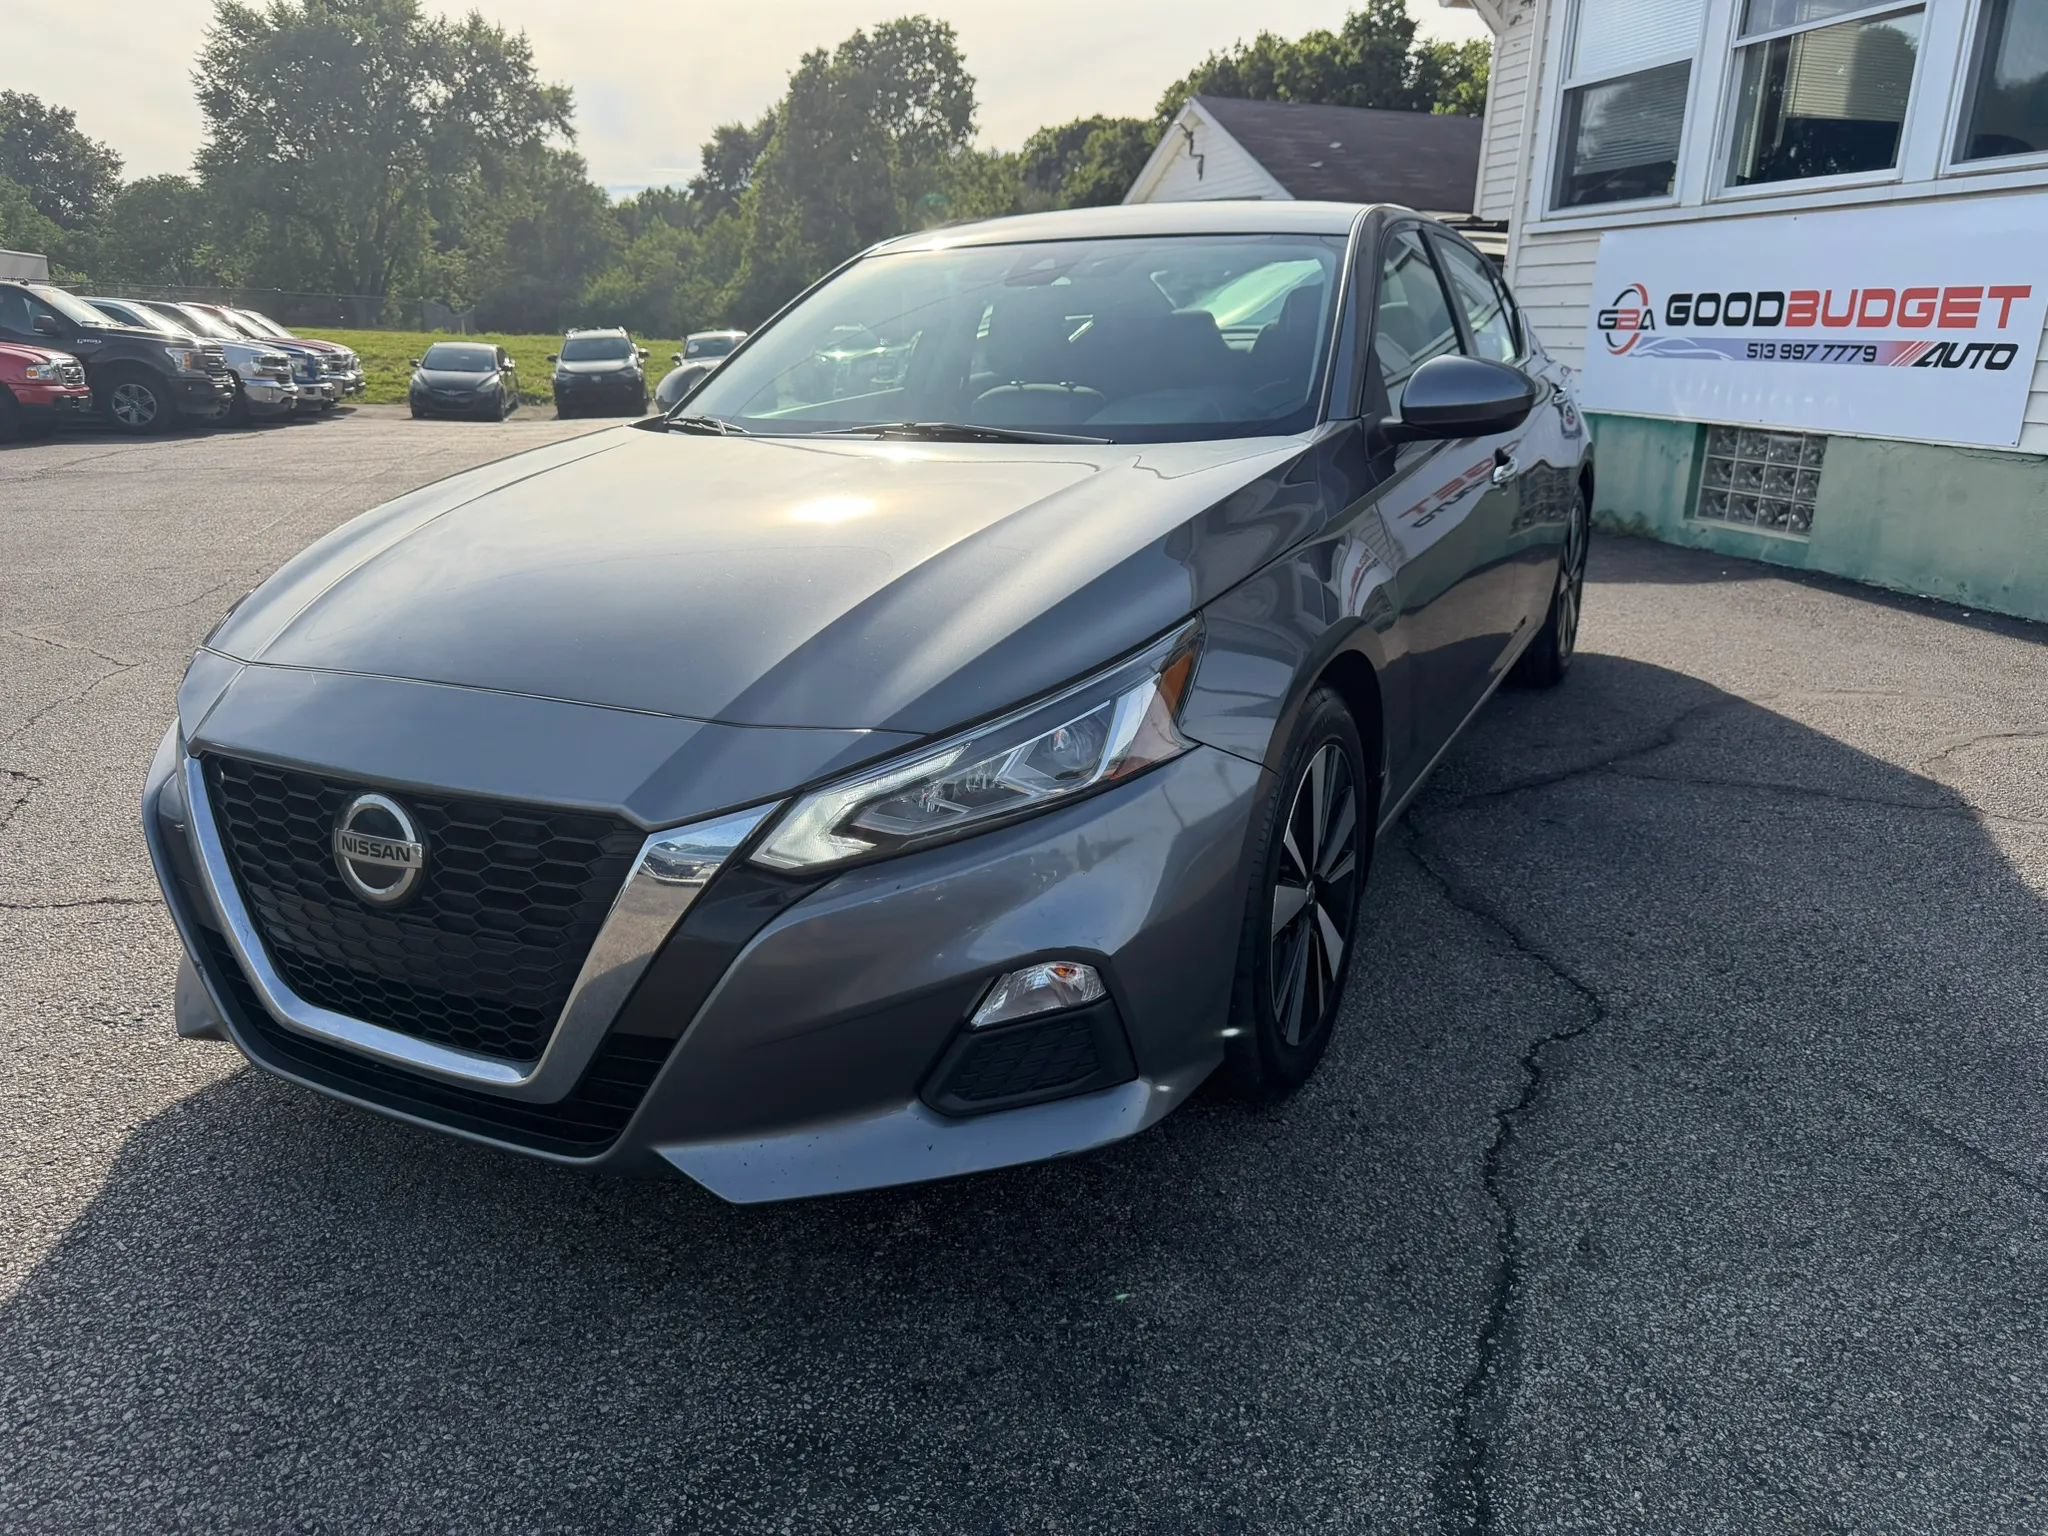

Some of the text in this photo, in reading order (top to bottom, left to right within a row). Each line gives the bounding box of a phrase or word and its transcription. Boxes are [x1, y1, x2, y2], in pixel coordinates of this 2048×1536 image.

[1597, 308, 1656, 331] GBA
[1746, 343, 1878, 363] 513 997 7779
[1912, 342, 2019, 370] AUTO
[341, 835, 411, 862] NISSAN
